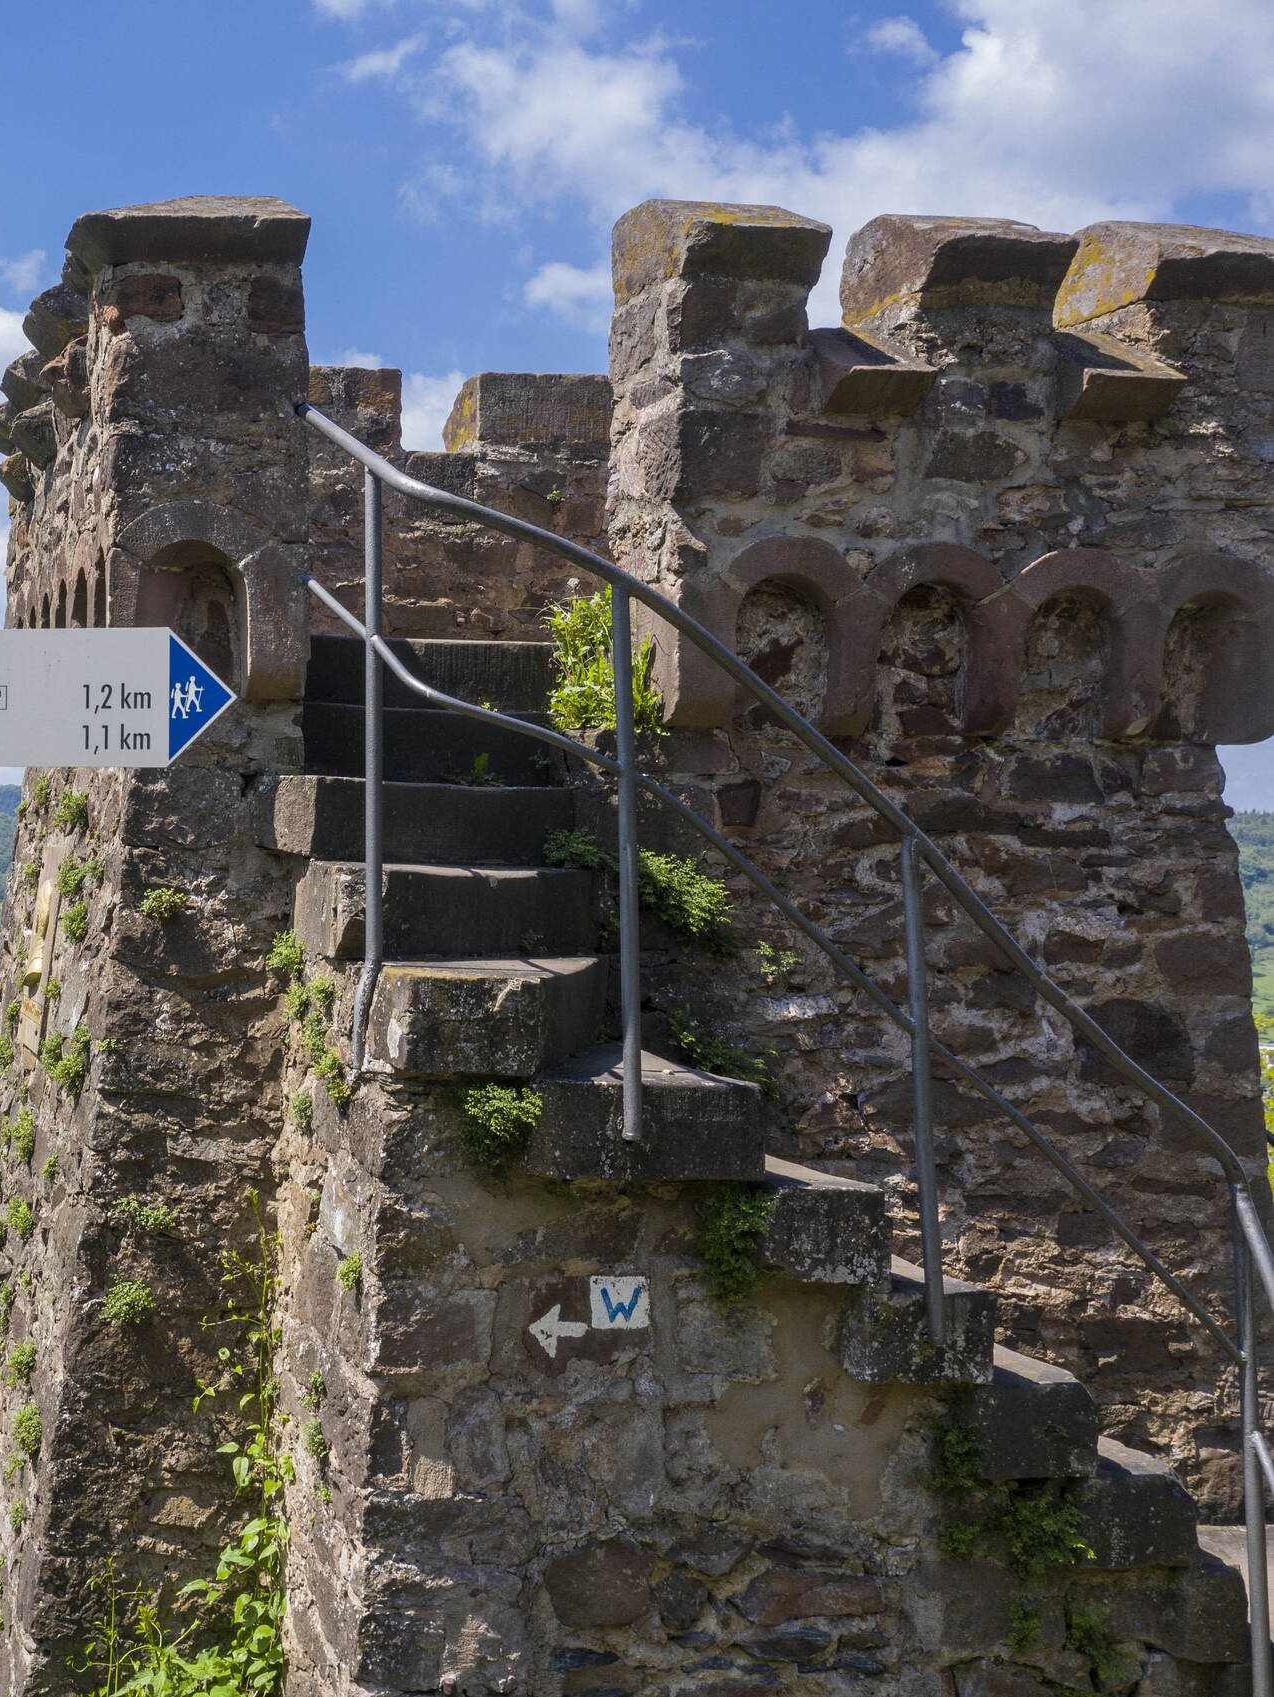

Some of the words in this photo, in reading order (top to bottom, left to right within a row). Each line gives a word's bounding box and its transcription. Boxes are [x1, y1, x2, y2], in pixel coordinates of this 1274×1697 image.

[82, 683, 112, 714] 1,2
[120, 683, 152, 710] km
[82, 724, 110, 755] 1,1
[120, 723, 151, 750] km
[600, 1287, 642, 1323] W
